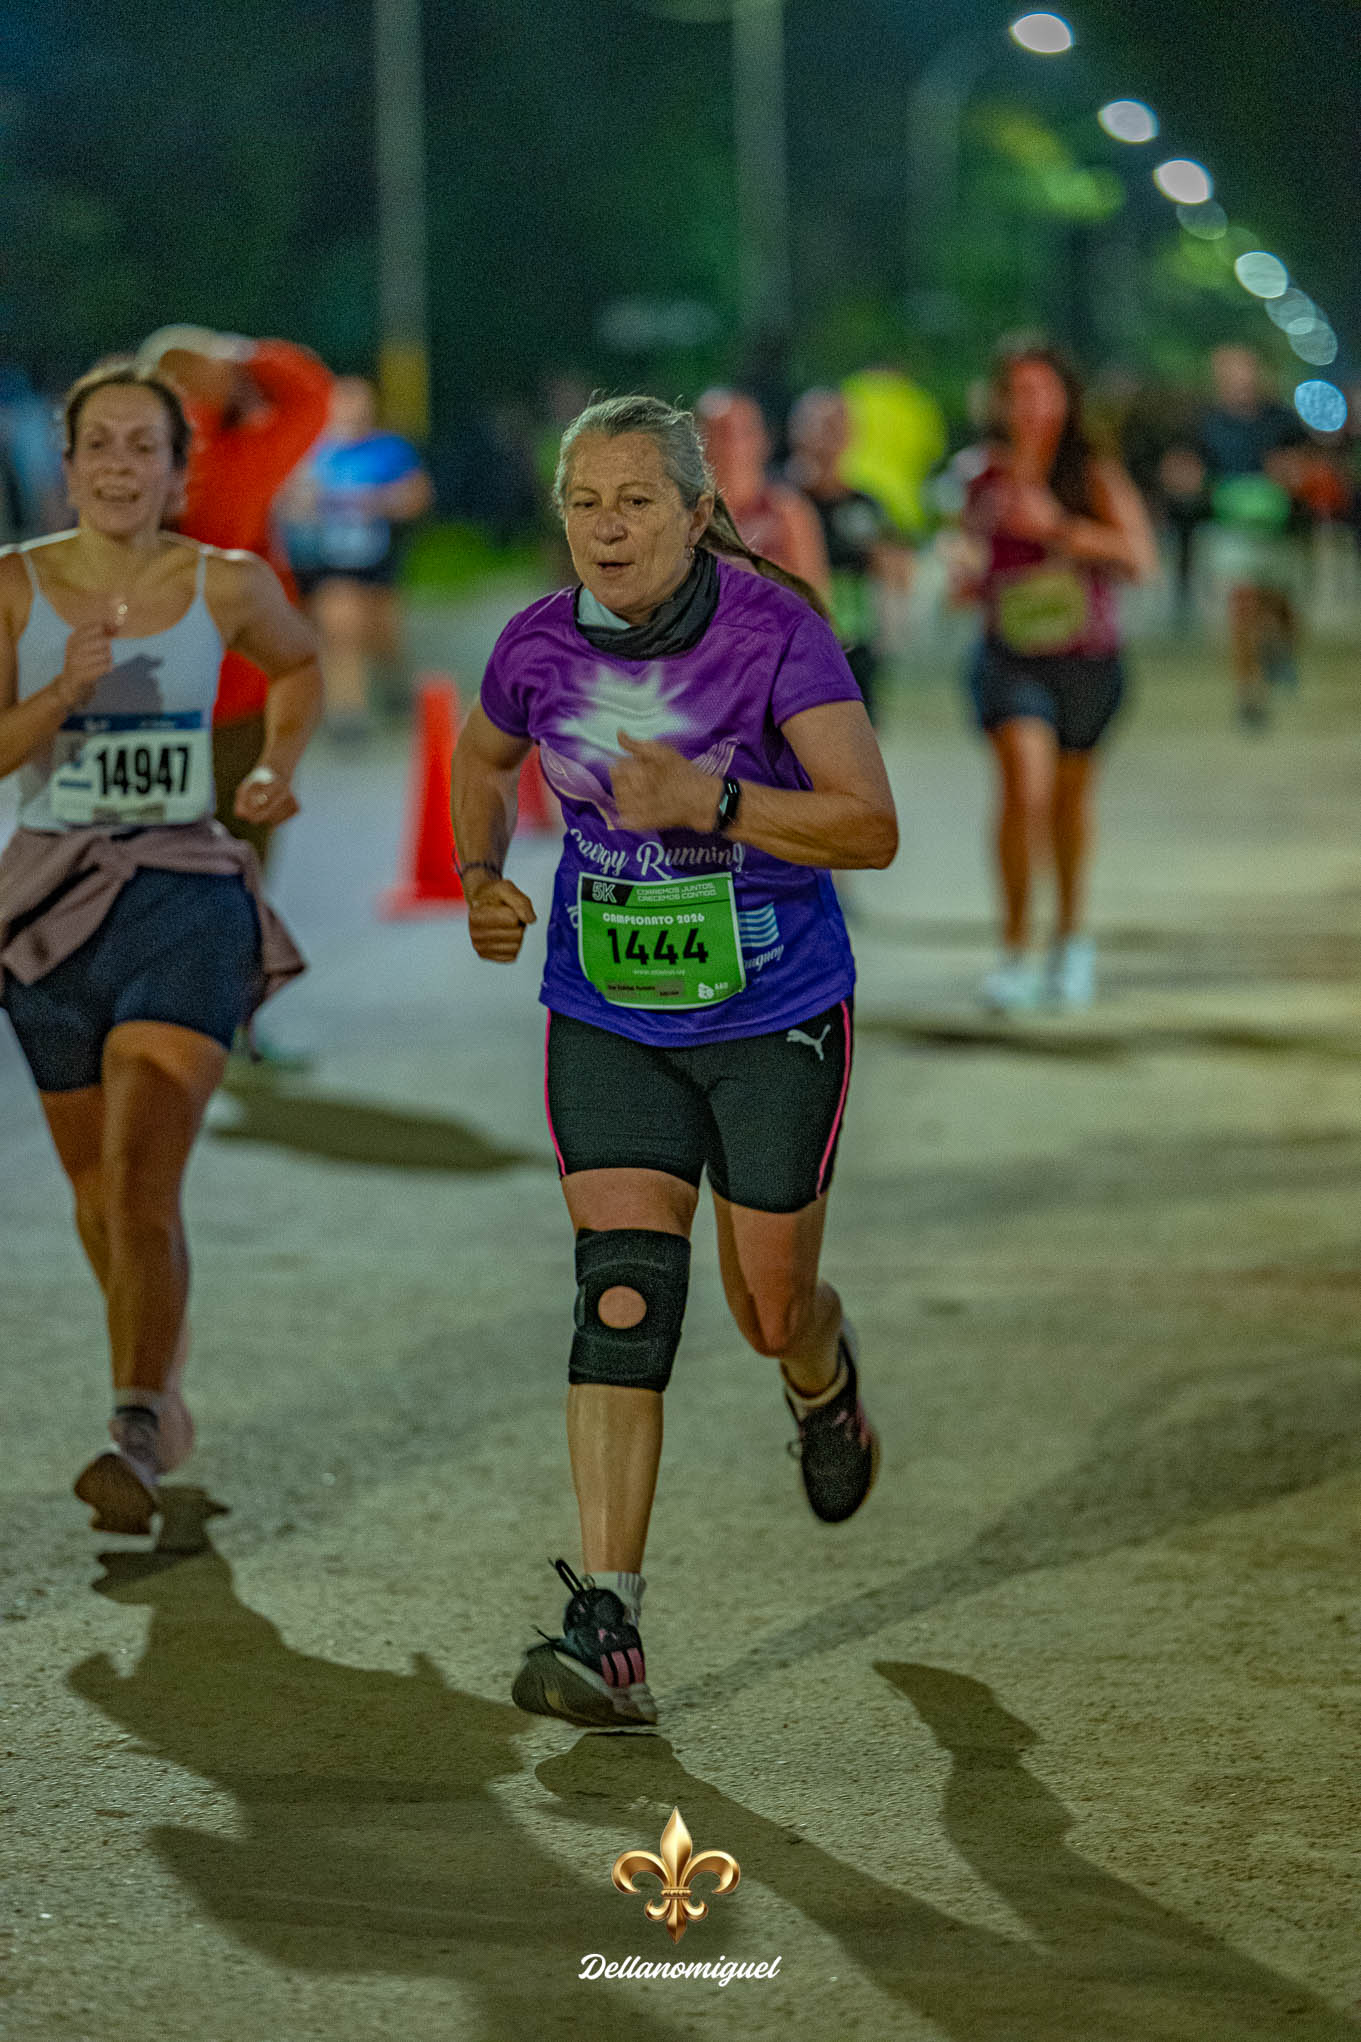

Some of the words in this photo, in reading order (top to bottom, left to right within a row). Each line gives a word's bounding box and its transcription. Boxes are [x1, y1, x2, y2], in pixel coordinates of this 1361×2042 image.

[97, 747, 189, 795] 14947
[636, 841, 746, 880] Running
[591, 881, 617, 904] 5K
[602, 912, 674, 925] CAMPEONATO
[677, 912, 705, 925] 2026
[607, 927, 709, 966] 1444
